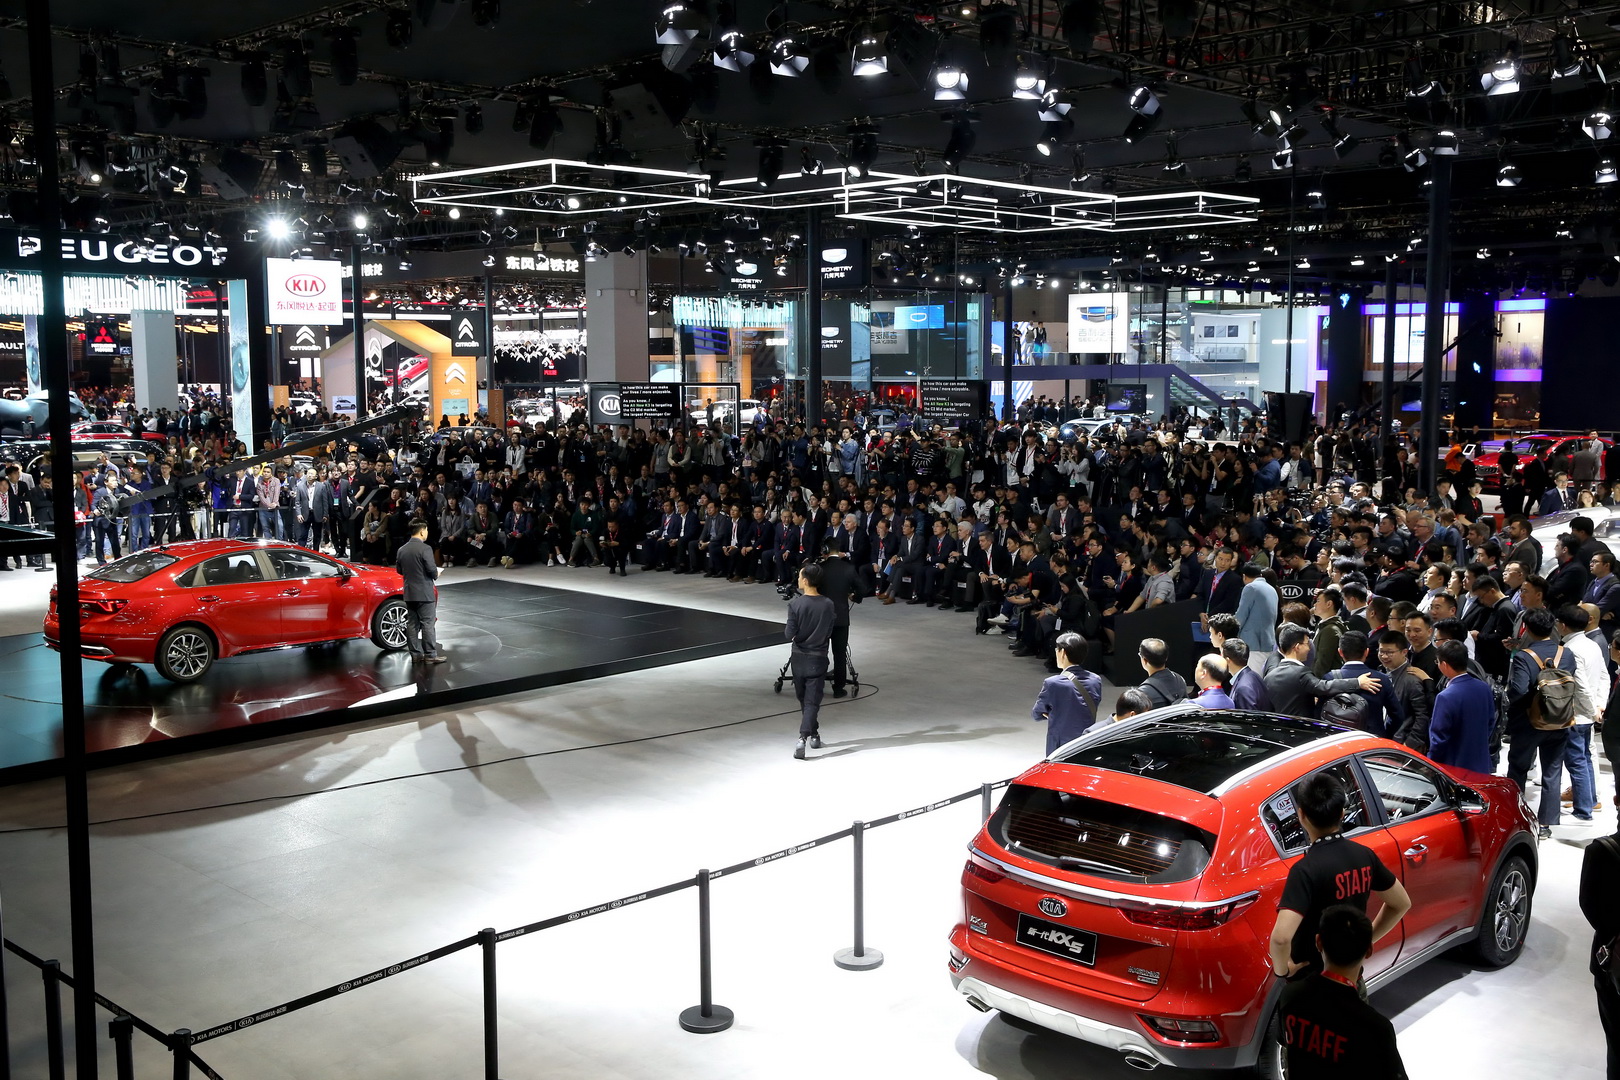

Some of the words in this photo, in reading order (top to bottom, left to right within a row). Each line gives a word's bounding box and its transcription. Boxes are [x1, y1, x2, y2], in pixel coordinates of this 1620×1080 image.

[293, 279, 319, 292] KIA
[603, 400, 620, 411] KIA
[1281, 588, 1299, 596] KIA
[1335, 866, 1372, 900] STAFF
[589, 905, 606, 914] MOTORS
[1042, 900, 1062, 914] KIA
[362, 972, 383, 983] MOTORS
[208, 1026, 232, 1037] MOTORS
[1285, 1014, 1348, 1063] STAFF
